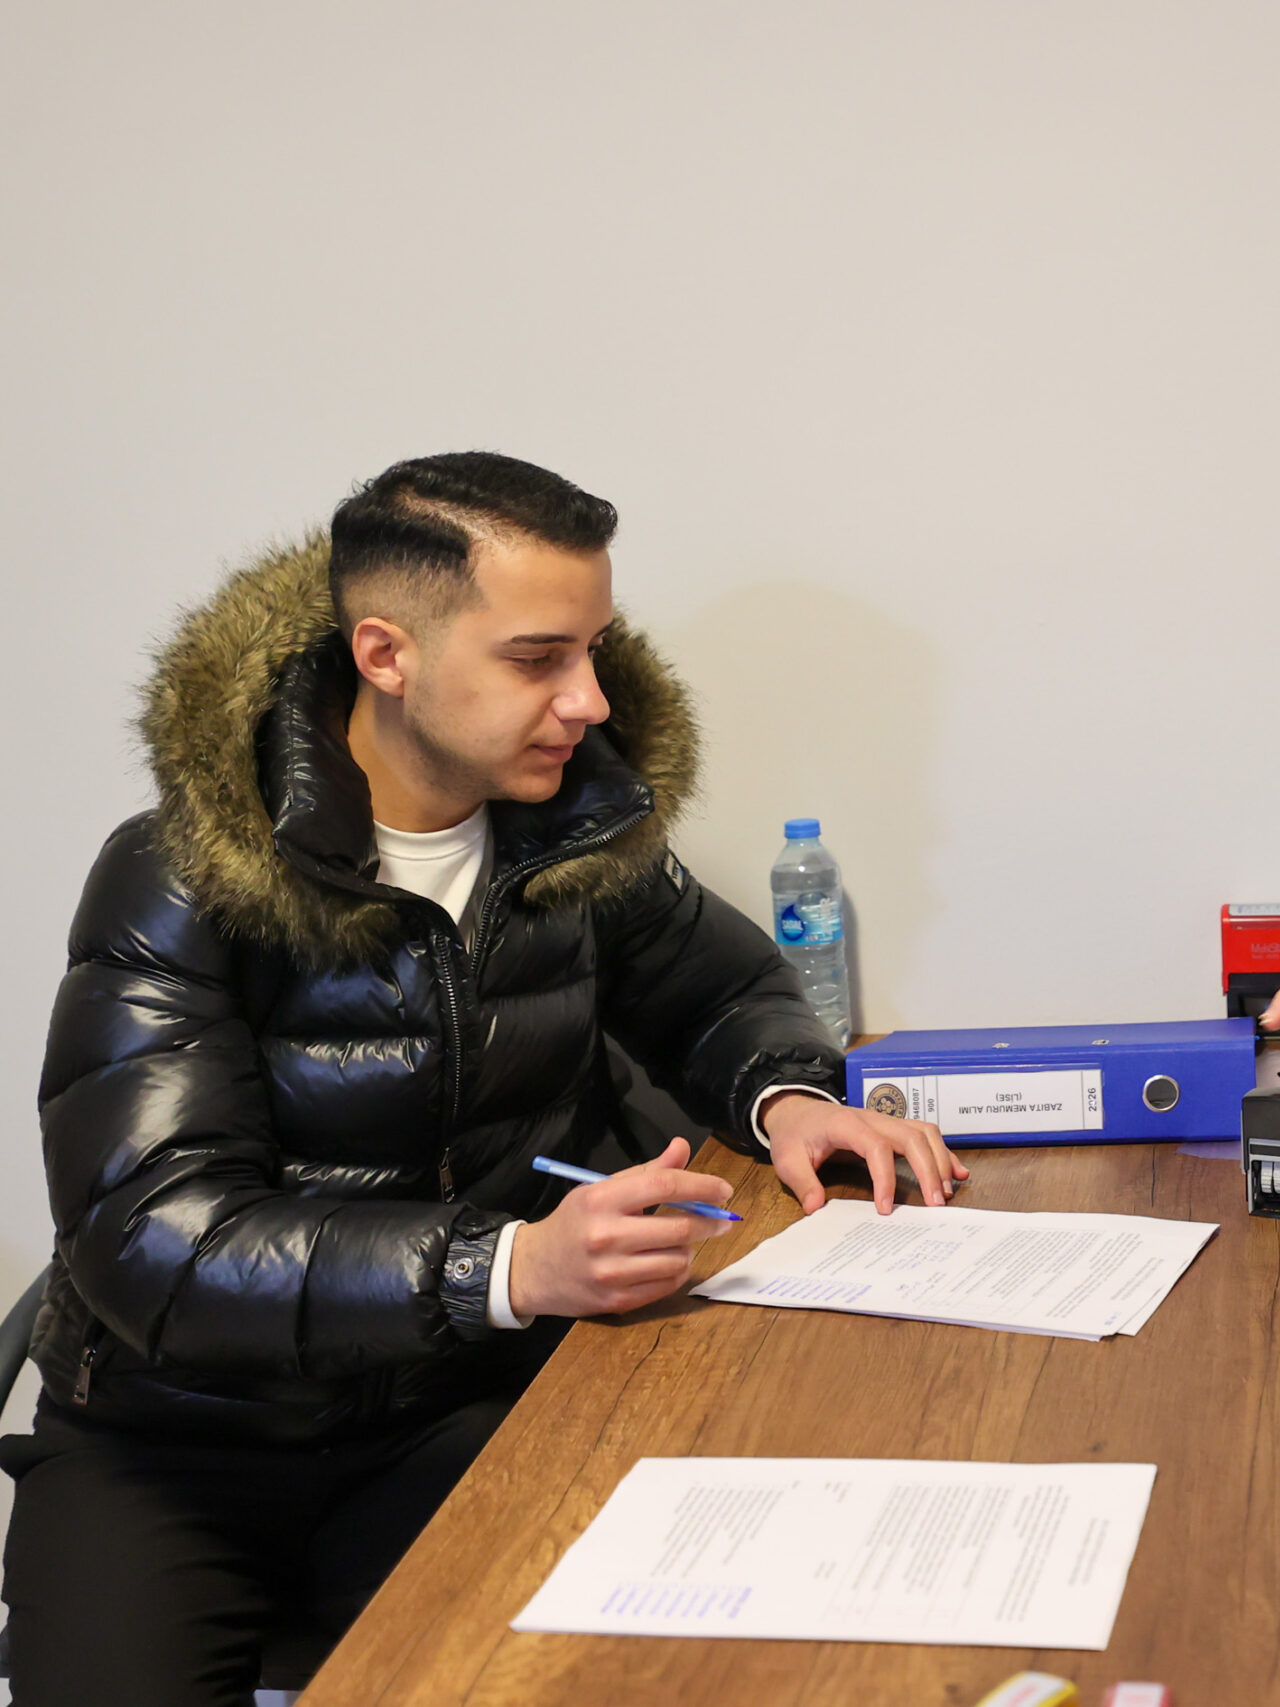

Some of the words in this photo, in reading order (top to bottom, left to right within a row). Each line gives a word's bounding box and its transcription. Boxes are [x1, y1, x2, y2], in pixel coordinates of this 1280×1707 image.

[927, 1098, 935, 1112] 900
[958, 1105, 984, 1114] ALIMI
[985, 1104, 1027, 1113] MEMURU
[1029, 1103, 1063, 1112] ZABITA
